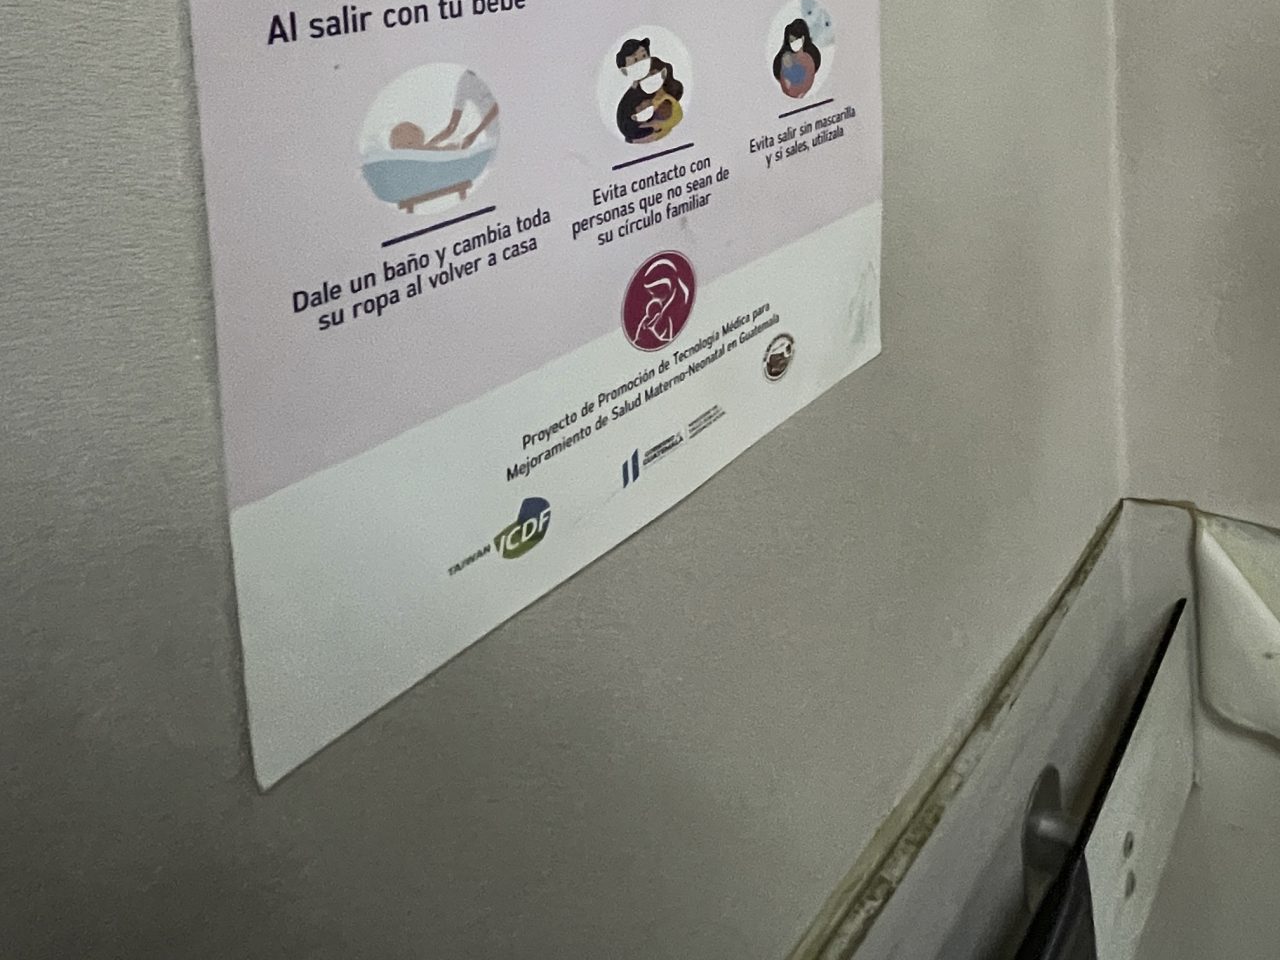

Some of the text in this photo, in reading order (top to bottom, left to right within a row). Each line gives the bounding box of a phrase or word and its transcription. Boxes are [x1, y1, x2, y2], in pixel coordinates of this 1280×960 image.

[267, 11, 297, 45] Al
[309, 5, 372, 38] salir
[383, 3, 429, 28] con
[750, 105, 856, 153] Evita salir sin mascarilla
[765, 153, 772, 169] y
[785, 140, 810, 158] sales,
[572, 166, 729, 240] personas que no sean de
[592, 157, 711, 206] Evita contacto con
[597, 191, 712, 246] su círculo familiar
[292, 208, 552, 313] Dale un baño y cambia toda
[318, 237, 538, 331] su ropa al volver a casa
[506, 312, 780, 481] Mejoramiento de Salud Materno-Neonatal en Guatemala
[522, 302, 770, 450] Proyecto de Promoción de Tecnología Médica para
[499, 506, 551, 556] ICDF
